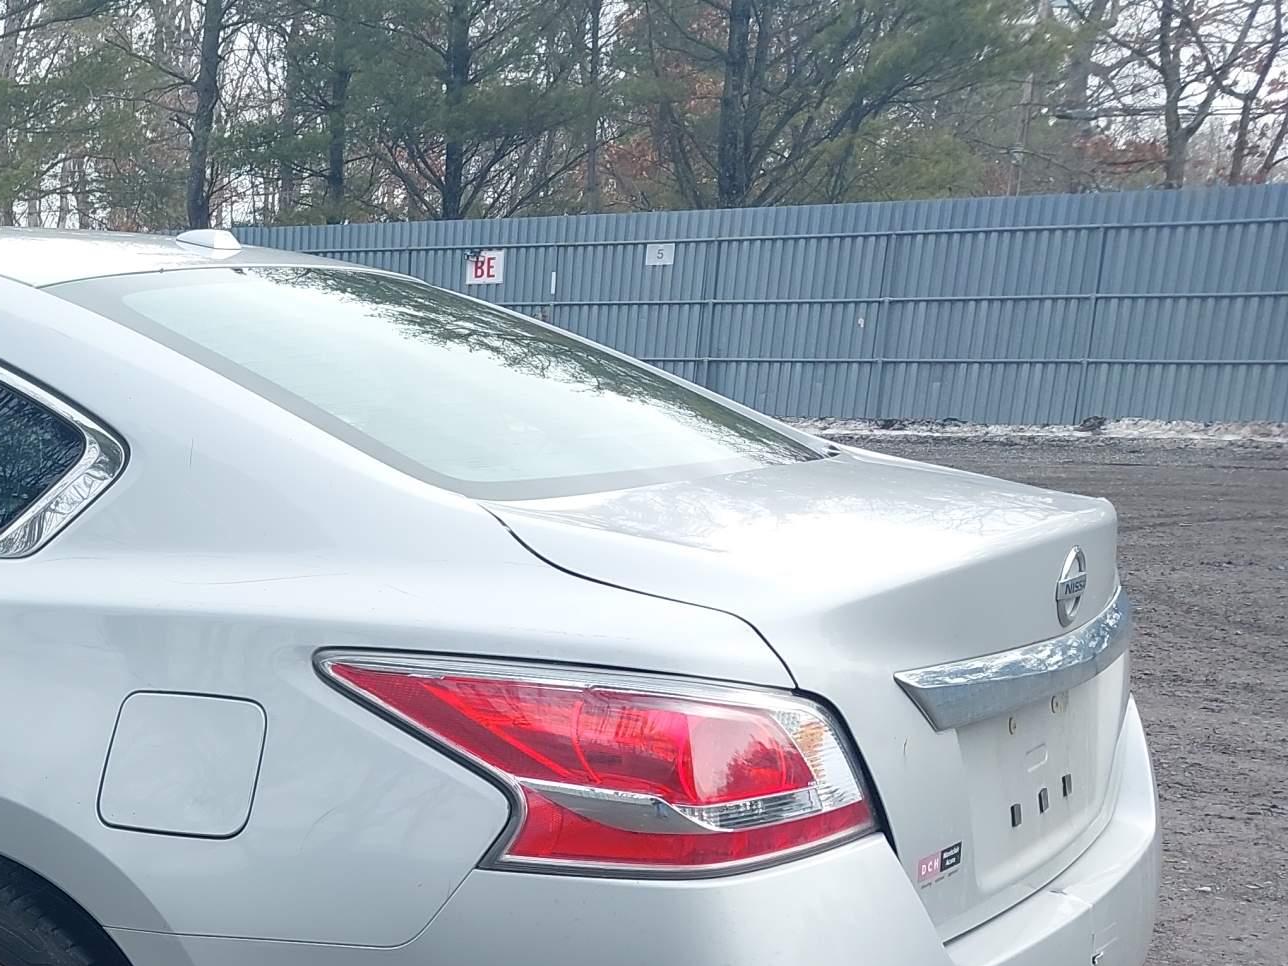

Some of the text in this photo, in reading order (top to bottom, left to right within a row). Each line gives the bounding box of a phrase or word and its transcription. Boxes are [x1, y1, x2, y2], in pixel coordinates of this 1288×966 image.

[656, 248, 664, 260] 5
[474, 256, 496, 278] BE
[921, 857, 939, 876] DCH
